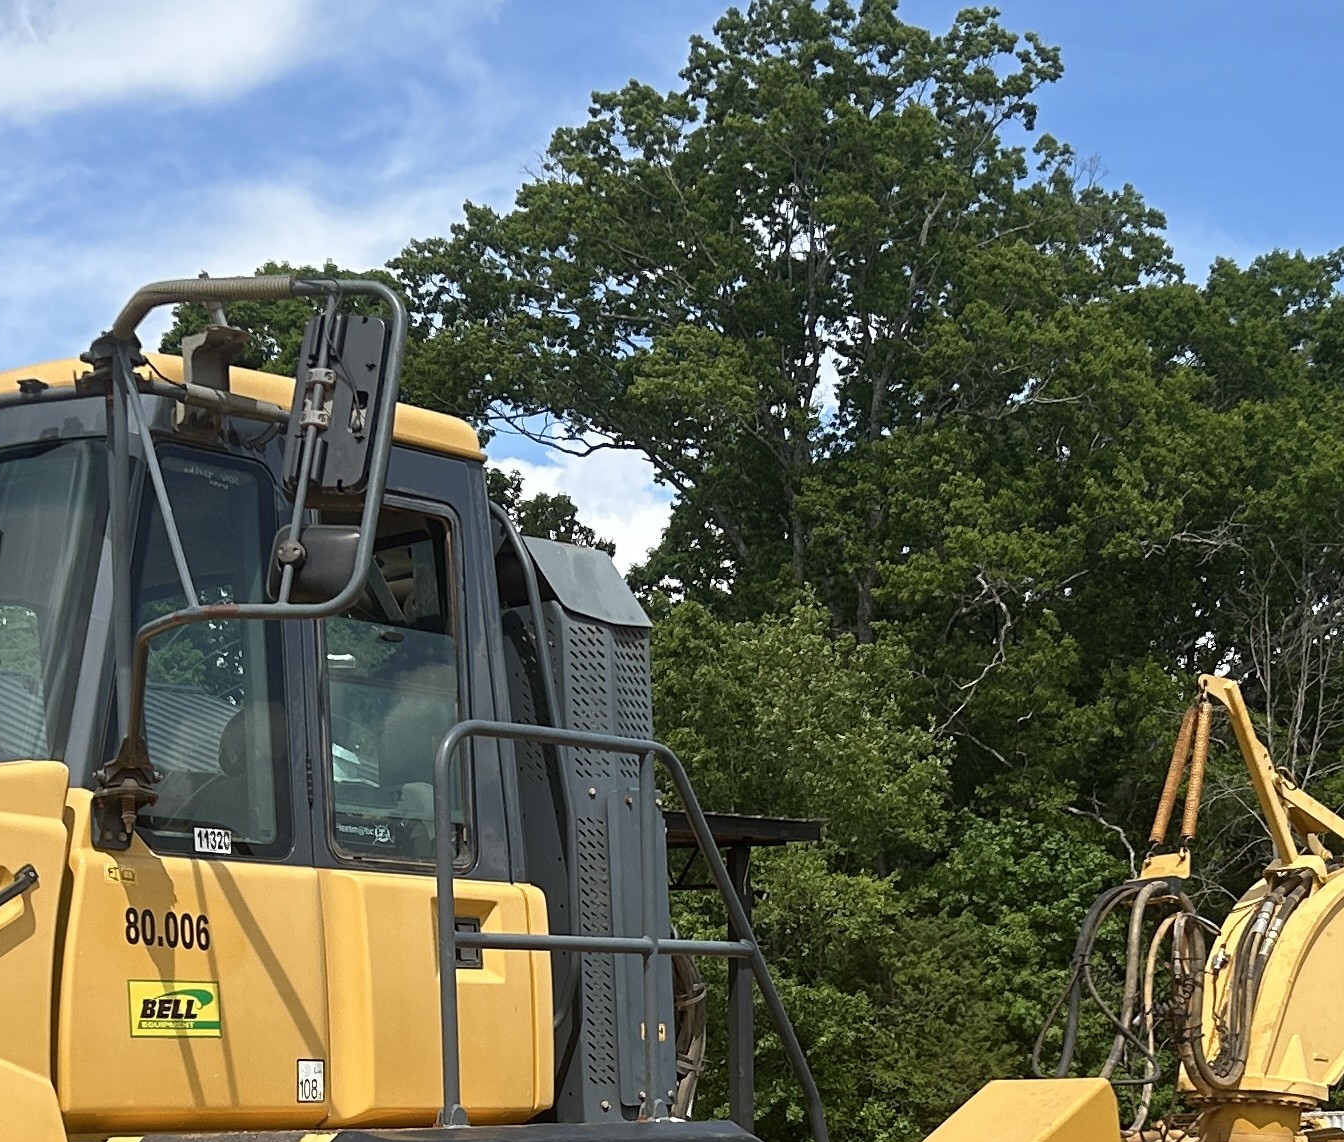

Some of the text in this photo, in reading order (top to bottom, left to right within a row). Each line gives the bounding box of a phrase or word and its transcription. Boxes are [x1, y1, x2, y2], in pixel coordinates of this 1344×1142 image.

[125, 907, 210, 951] 80.006
[139, 998, 198, 1020] BELL
[299, 1078, 318, 1100] 108
